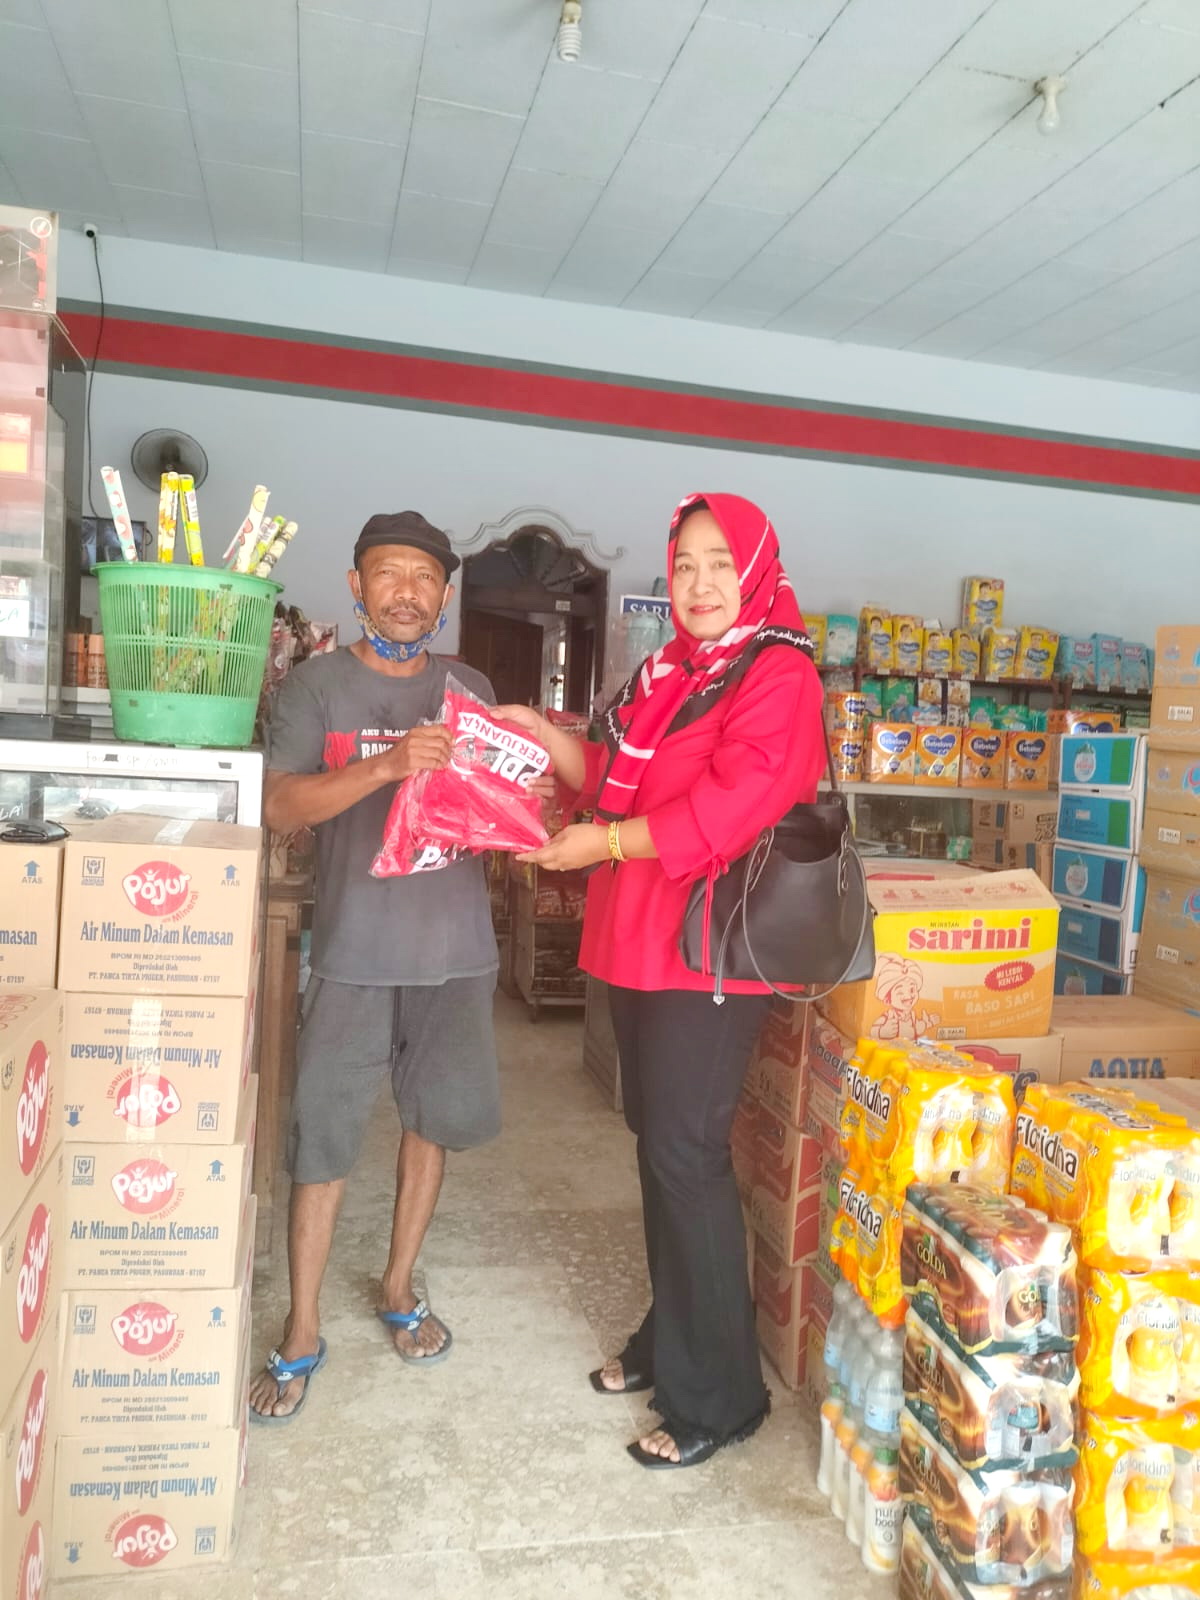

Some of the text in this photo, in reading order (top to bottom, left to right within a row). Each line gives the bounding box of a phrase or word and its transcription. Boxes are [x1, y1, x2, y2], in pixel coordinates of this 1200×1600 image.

[80, 921, 233, 946] Air Minum Dalam Kemasan
[908, 917, 1031, 951] sarimi
[998, 974, 1023, 988] KENYAL
[953, 990, 979, 999] RASA
[965, 991, 1034, 1015] BASO SAPI
[70, 1043, 221, 1069] Air Minum Dalam Kemasan
[70, 1220, 219, 1240] Air Minum Dalam Kemasan
[917, 1242, 947, 1280] GOLDA
[72, 1367, 220, 1388] Air Minum Dalam Kemasan
[70, 1476, 217, 1501] Air Minum Dalam Kemasan
